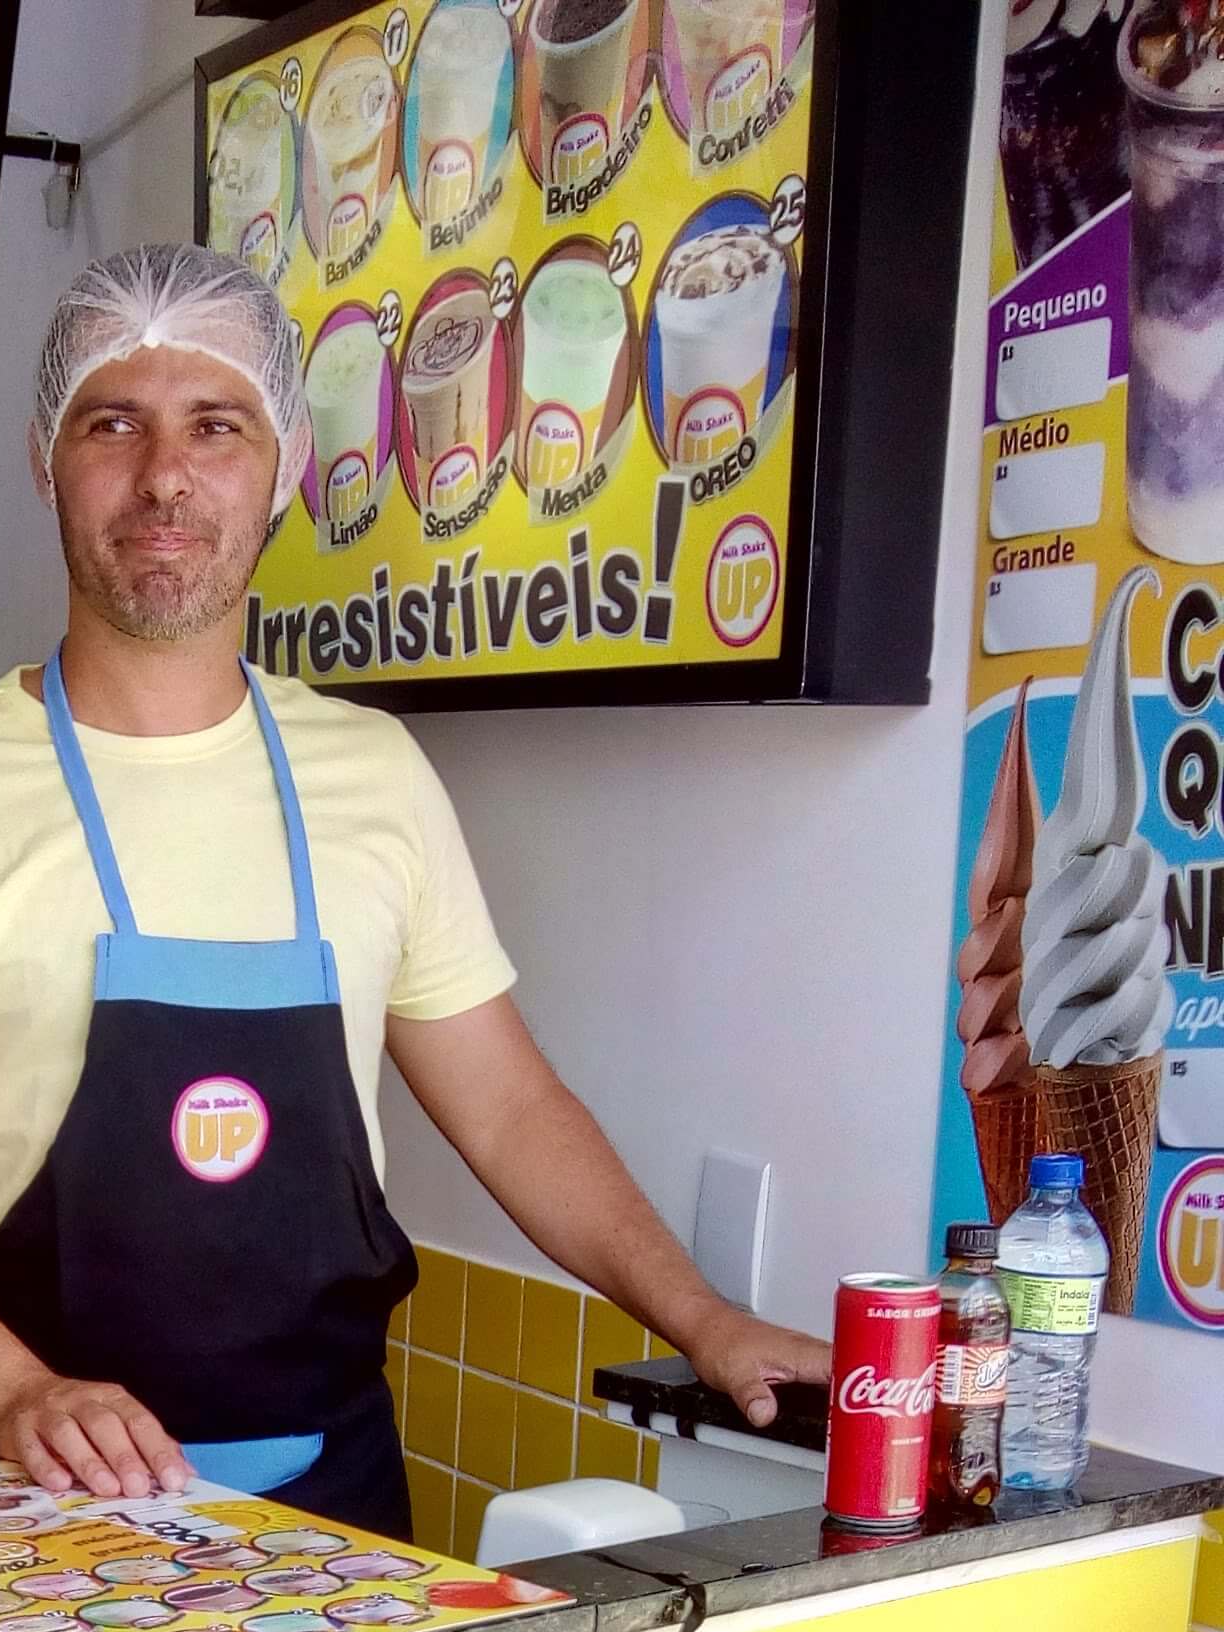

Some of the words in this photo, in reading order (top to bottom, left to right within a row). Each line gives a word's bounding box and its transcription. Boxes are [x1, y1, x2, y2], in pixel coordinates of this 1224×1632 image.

[697, 78, 795, 166] Confetti
[546, 102, 653, 216] Brigadeiro
[771, 188, 805, 232] 25
[325, 220, 382, 287] Banana
[609, 234, 640, 268] 24
[491, 272, 514, 306] 23
[1004, 283, 1107, 333] Pequeno
[377, 303, 400, 334] 22
[999, 418, 1070, 458] Médio
[541, 462, 607, 517] Menta
[690, 436, 757, 502] OREO
[425, 455, 508, 538] Sensação
[330, 502, 378, 546] Limão
[245, 481, 685, 677] Irresistíveis!
[993, 535, 1075, 575] Grande
[716, 557, 772, 623] UP
[186, 1112, 258, 1163] UP
